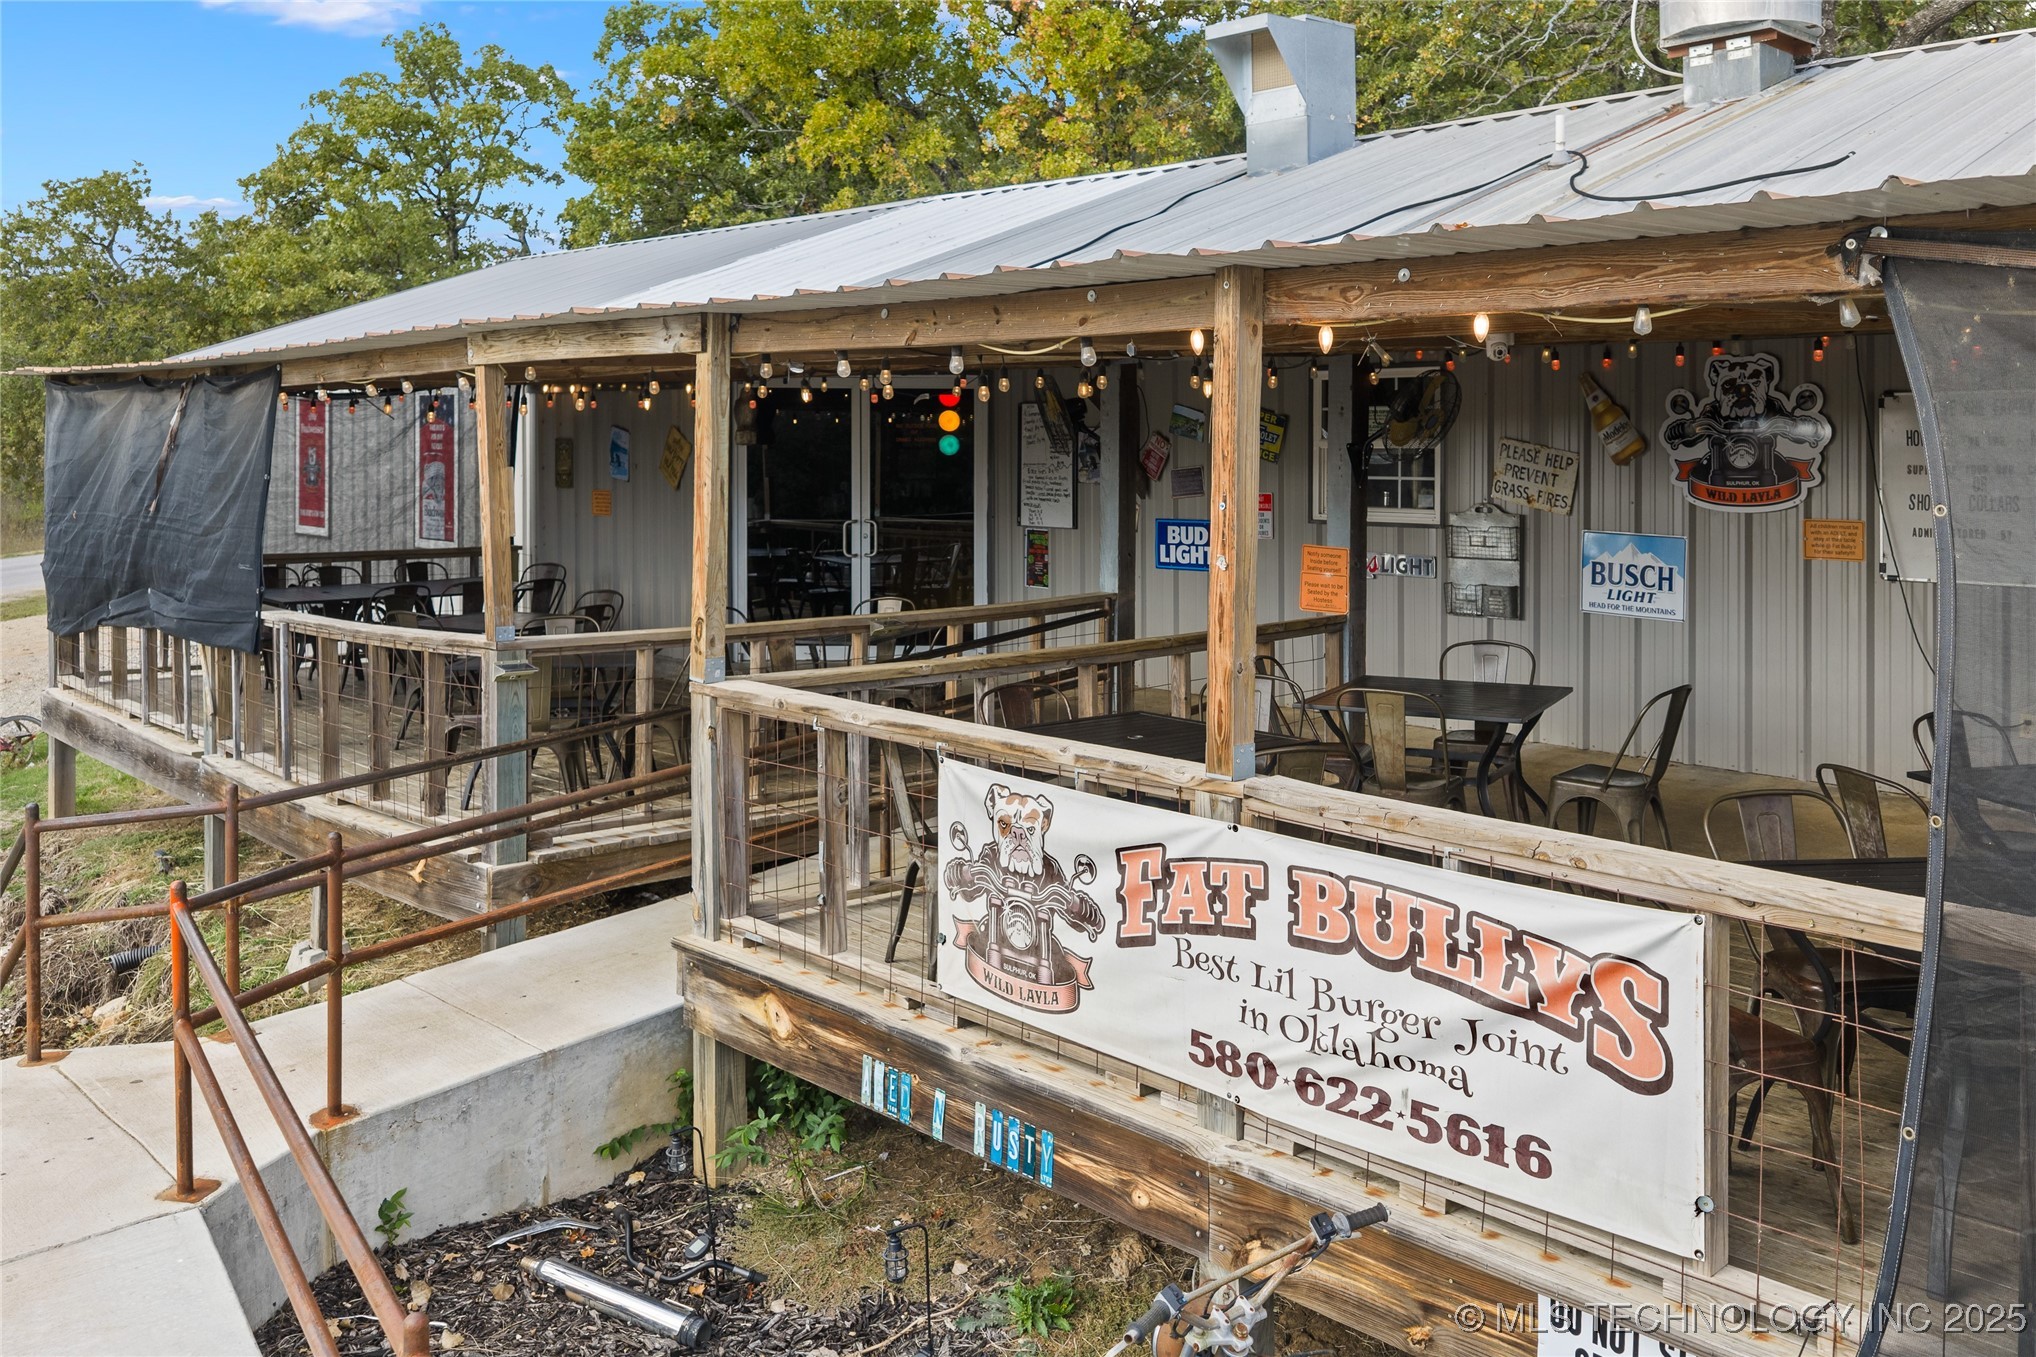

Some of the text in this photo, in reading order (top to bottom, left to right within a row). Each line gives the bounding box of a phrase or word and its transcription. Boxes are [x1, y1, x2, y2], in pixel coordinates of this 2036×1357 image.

[1154, 436, 1165, 449] NO
[1499, 443, 1574, 471] PLEASE HELP
[1504, 463, 1559, 487] PREVENT
[1494, 479, 1568, 509] GRASS FIRES
[1706, 488, 1781, 502] WILD LAYLA
[1969, 494, 2020, 513] COLLARS
[1167, 526, 1208, 545] BUD
[1381, 556, 1433, 576] LIGHT
[1591, 561, 1674, 592] BUSCH
[1607, 589, 1656, 604] LIGHT
[1636, 606, 1676, 616] MOUNTAINS
[1003, 963, 1028, 978] SULPHUR,
[1115, 842, 1674, 1096] FAT BULLYS
[982, 967, 1059, 1005] WILD LAYLA
[1172, 936, 1569, 1075] Best Lil Burger Joint
[1238, 998, 1474, 1098] in Oklahoma
[934, 1097, 945, 1125] N
[974, 1112, 1052, 1173] RUSTY
